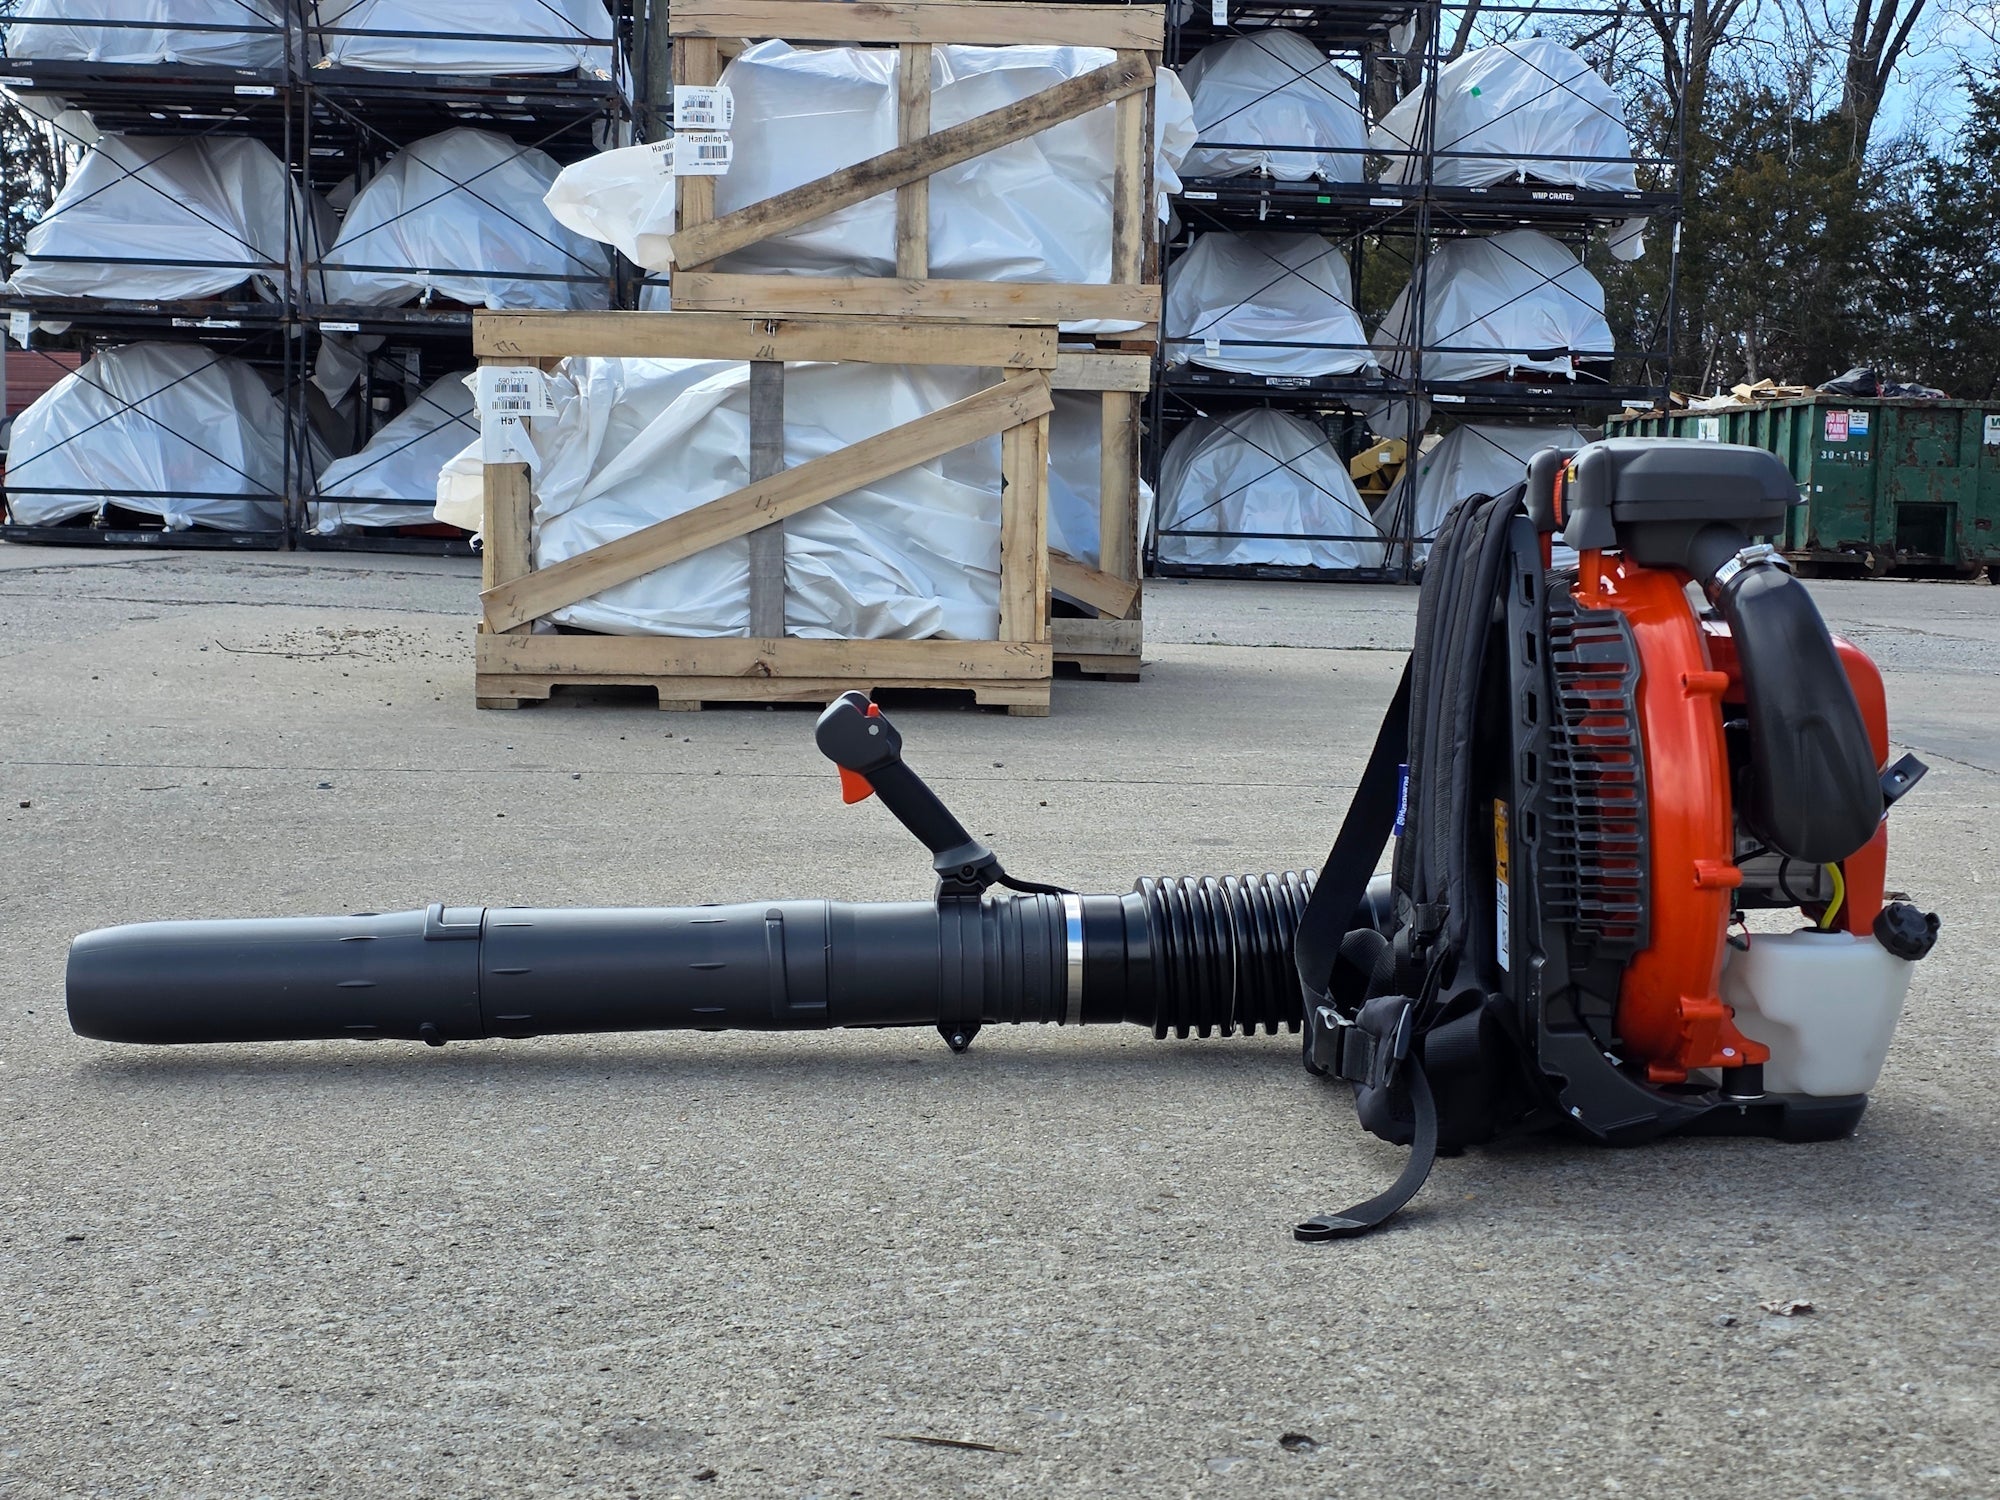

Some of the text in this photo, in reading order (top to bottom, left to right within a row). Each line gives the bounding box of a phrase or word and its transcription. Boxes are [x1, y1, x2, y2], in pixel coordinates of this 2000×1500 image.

[688, 135, 722, 144] Handling
[1532, 192, 1575, 201] WMP CRATES
